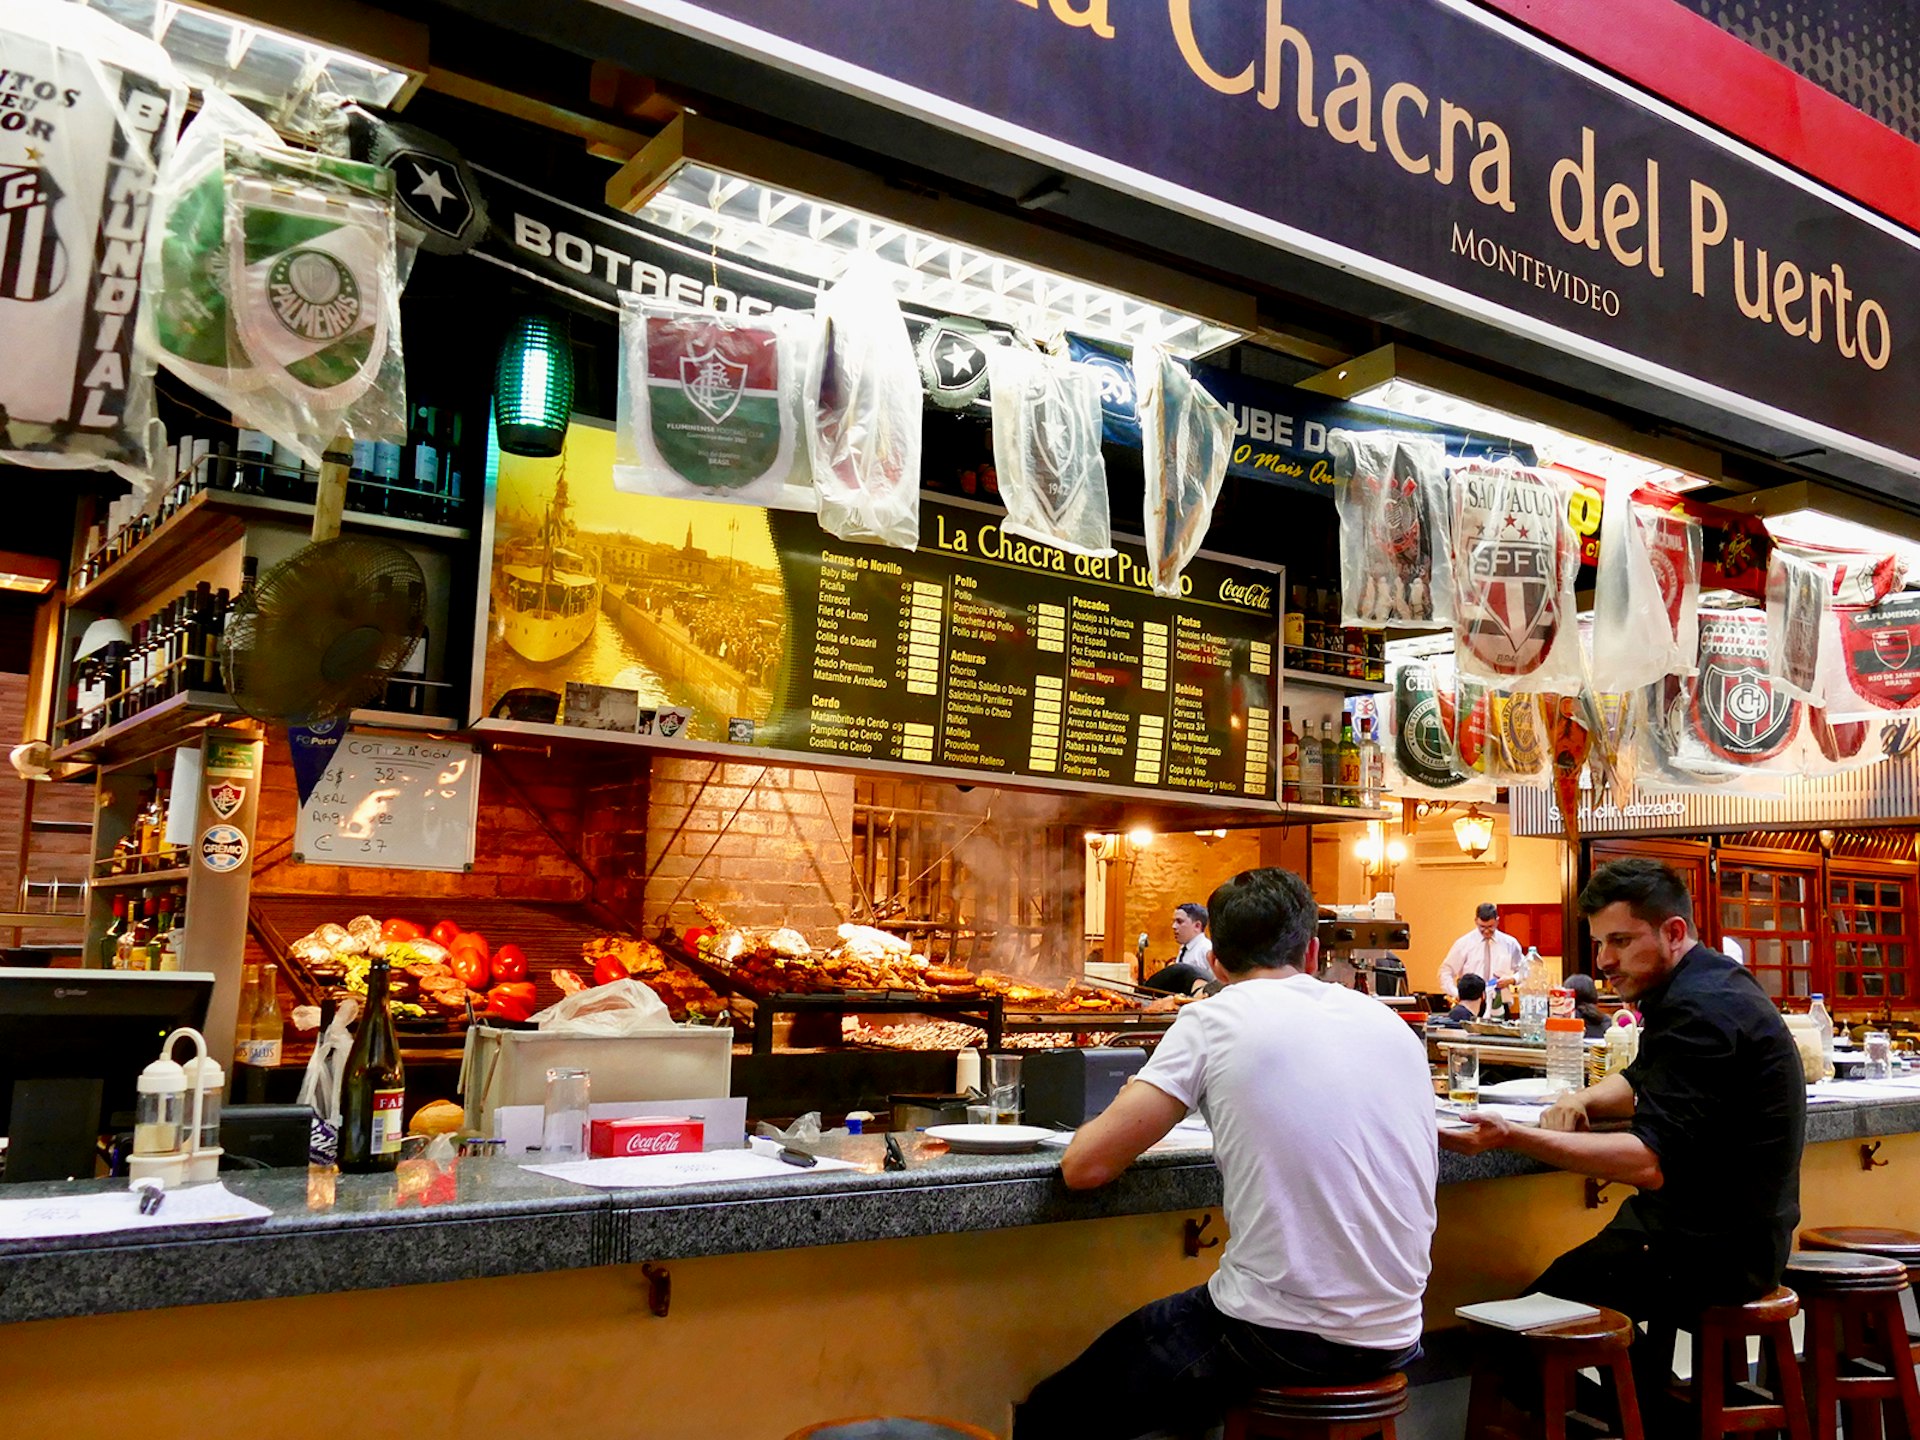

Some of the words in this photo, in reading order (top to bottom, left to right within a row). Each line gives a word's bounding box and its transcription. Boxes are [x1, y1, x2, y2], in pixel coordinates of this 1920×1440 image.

[1168, 0, 1515, 213] Chacra
[1549, 126, 1664, 278] del
[1690, 179, 1892, 370] Puerto
[514, 212, 812, 320] BOTAFO
[1450, 222, 1621, 317] MONTEVIDEO
[270, 283, 359, 338] PALMEIRAS
[666, 423, 716, 434] FLUMINENSE
[1234, 444, 1252, 464] O
[1254, 449, 1305, 478] Mais
[1468, 478, 1494, 508] SÃO
[822, 550, 855, 567] Carnes
[857, 558, 868, 569] de
[870, 559, 902, 575] Novillo
[937, 514, 968, 552] La
[978, 523, 1066, 573] Chacra
[1118, 555, 1193, 596] Pueo
[821, 566, 840, 579] Baby
[842, 570, 858, 581] Beef
[955, 574, 977, 589] Pollo
[819, 592, 850, 606] Entrecot
[954, 589, 972, 600] Pollo
[1218, 577, 1271, 609] Coca-Cola
[1073, 596, 1110, 612] Pescados
[817, 605, 834, 616] Filet
[835, 608, 845, 618] de
[847, 610, 869, 622] Lomo
[989, 607, 1006, 619] Pollo
[997, 621, 1014, 632] Pollo
[1177, 615, 1201, 628] Pastas
[816, 631, 838, 644] Colita
[839, 634, 849, 645] de
[850, 636, 877, 648] Cuadril
[952, 626, 970, 637] Pollo
[815, 644, 839, 656] Asado
[951, 650, 986, 665] Achuras
[814, 657, 838, 669] Asado
[840, 660, 874, 673] Premium
[950, 664, 977, 677] Chorizo
[813, 670, 852, 684] Matambre
[853, 675, 887, 689] Arrollado
[1069, 691, 1105, 705] Mariscos
[1175, 683, 1203, 697] Bebidas
[812, 694, 840, 709] Cerdo
[811, 711, 855, 725] Matambrito
[867, 717, 889, 730] Cerdo
[311, 736, 337, 746] Porto
[810, 724, 848, 738] Pamplona
[860, 730, 882, 742] Cerdo
[809, 737, 837, 748] Costilla
[850, 742, 872, 753] Cerdo
[250, 1047, 275, 1062] SALUS
[626, 1130, 682, 1153] Coca-Cola
